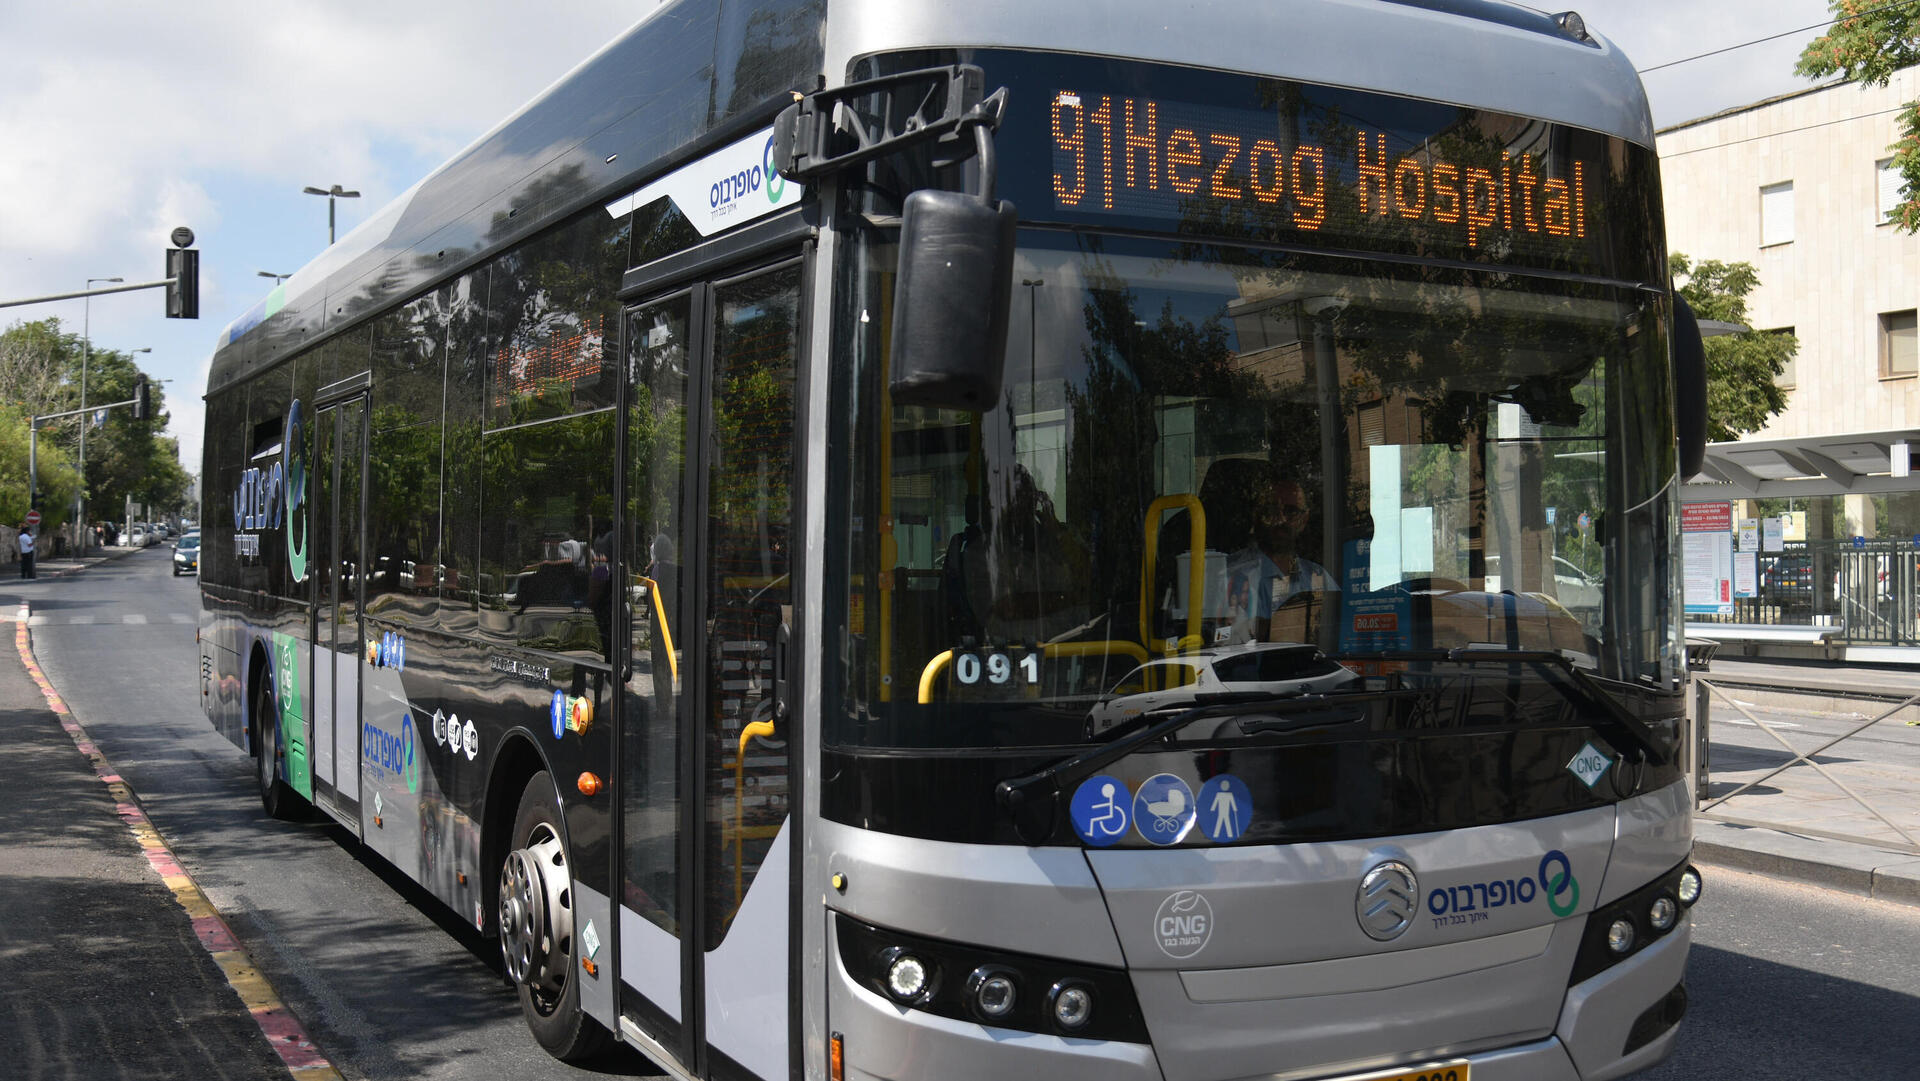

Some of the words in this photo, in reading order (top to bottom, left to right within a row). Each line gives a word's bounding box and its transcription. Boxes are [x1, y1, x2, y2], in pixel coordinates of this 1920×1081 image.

[1052, 90, 1112, 208] 91
[1126, 99, 1324, 230] Hezog
[1358, 131, 1585, 247] Hospital
[710, 165, 761, 208] סופרבוס
[957, 653, 1038, 684] 091
[364, 722, 403, 775] סופרבוס
[1576, 755, 1602, 774] CNG
[1428, 877, 1536, 916] סופרבוס
[1161, 915, 1206, 936] CNG
[1432, 917, 1448, 929] דרך
[1450, 914, 1466, 926] בכל
[1469, 912, 1489, 925] איתך
[1165, 938, 1178, 947] בגז
[1179, 936, 1201, 946] הנעה
